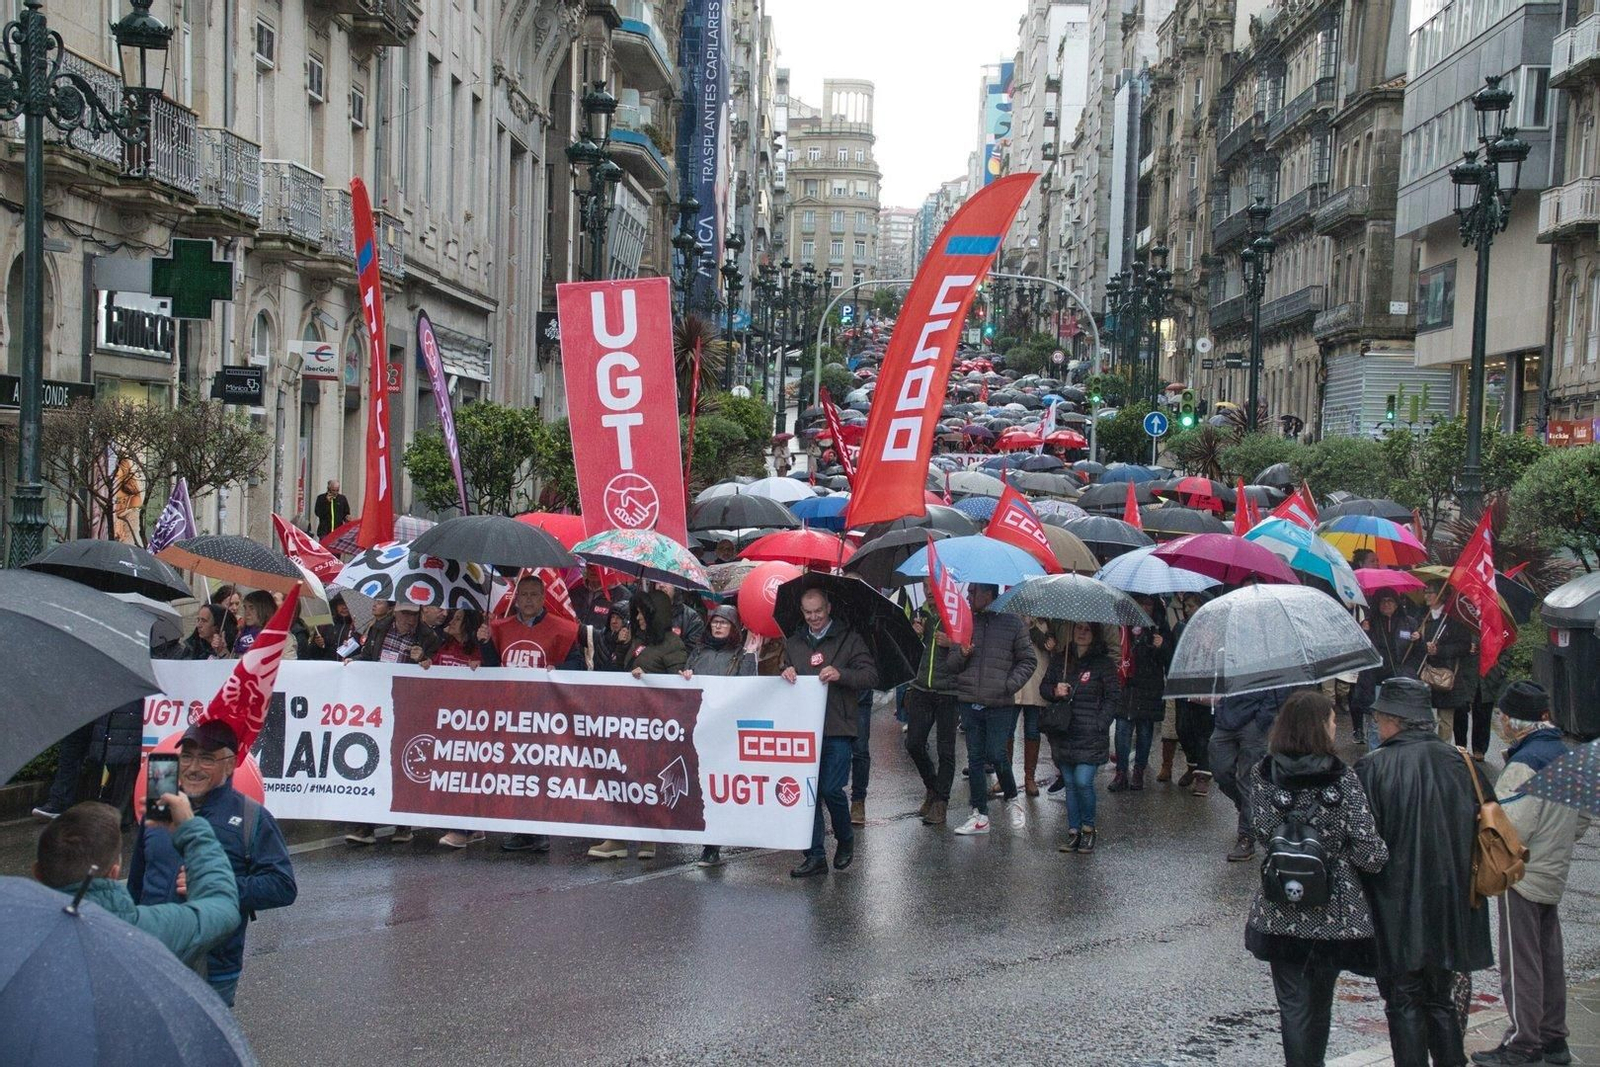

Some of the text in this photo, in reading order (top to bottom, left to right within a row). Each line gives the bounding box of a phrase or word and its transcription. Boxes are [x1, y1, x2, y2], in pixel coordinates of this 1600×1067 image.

[702, 2, 720, 184] TRASPLANTES CAPILARES
[590, 289, 643, 470] UGT
[881, 275, 977, 461] CCOO
[506, 650, 541, 667] UGT
[320, 703, 382, 728] 2024
[436, 708, 686, 741] POLO PLENO EMPREGO:
[433, 740, 628, 774] MENOS XORNADA,
[743, 736, 810, 757] CCOO
[309, 783, 376, 797] #1MAIO2024
[429, 770, 659, 806] MELLORES SALARIOS
[708, 773, 770, 806] UGT
